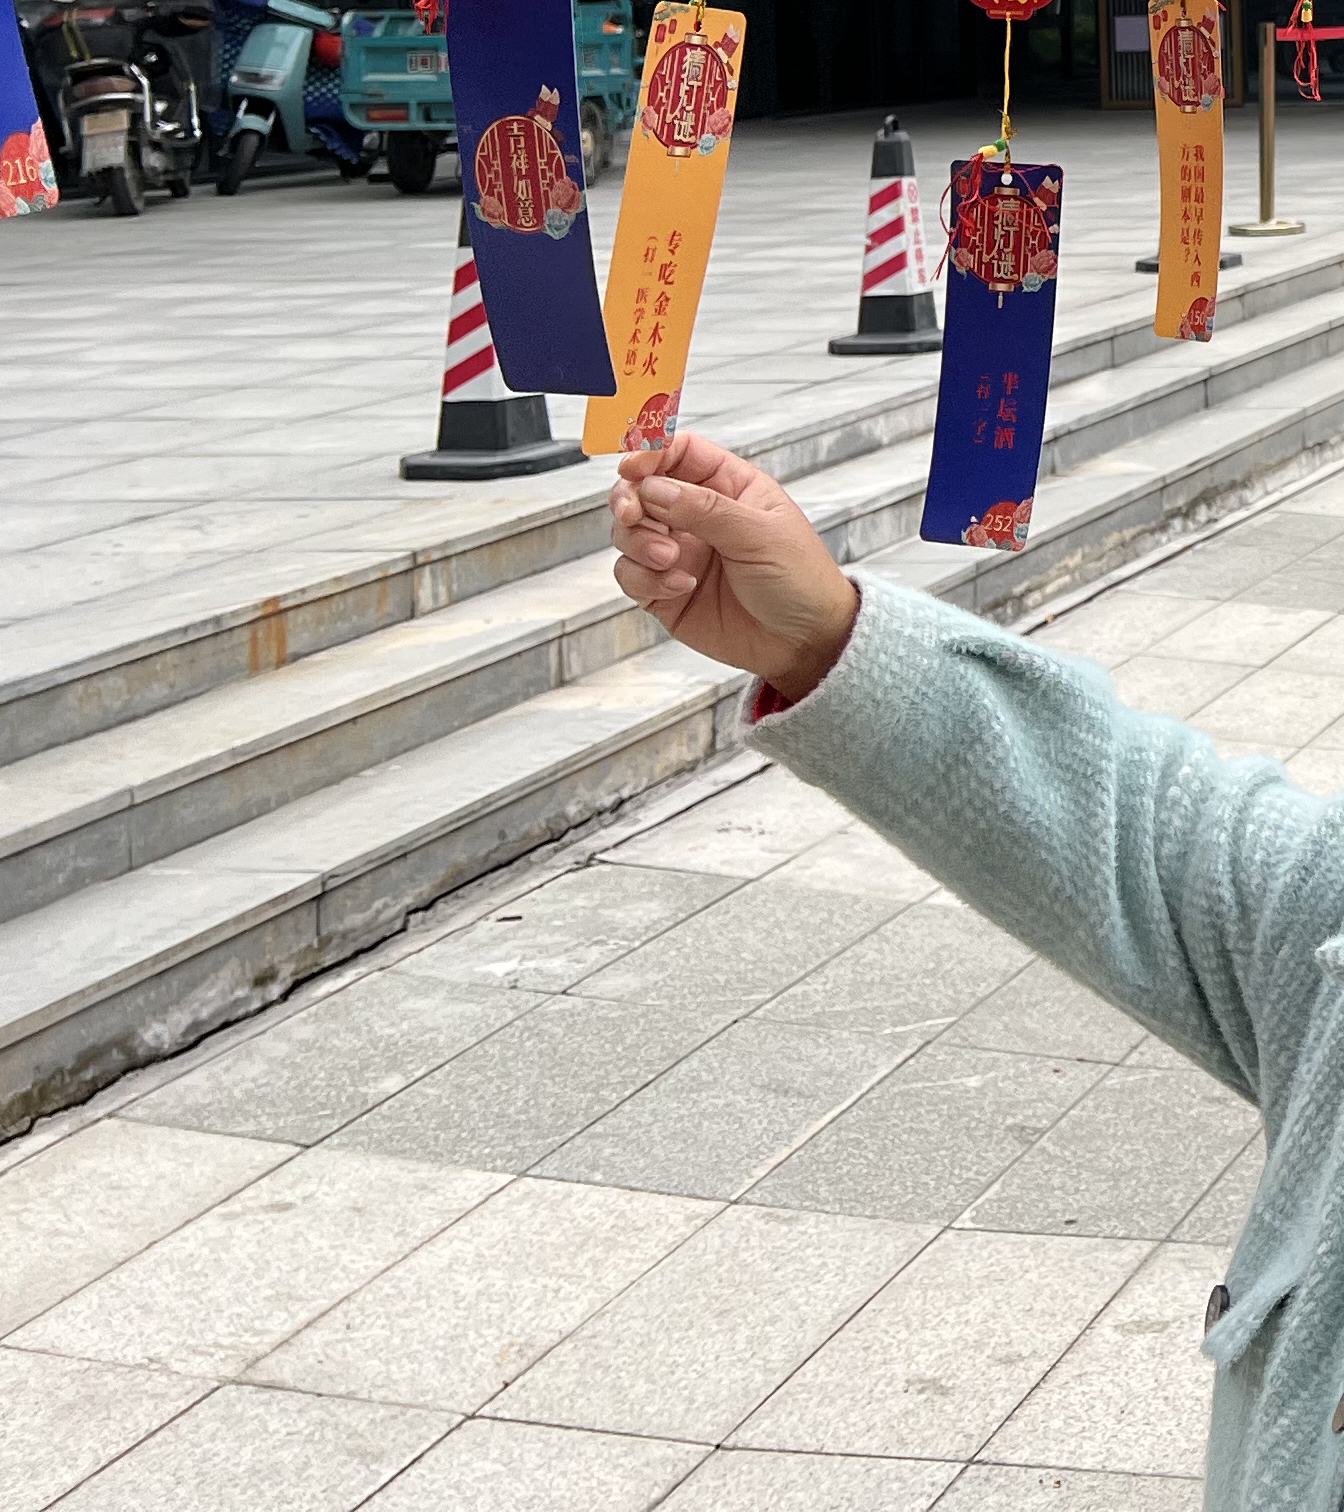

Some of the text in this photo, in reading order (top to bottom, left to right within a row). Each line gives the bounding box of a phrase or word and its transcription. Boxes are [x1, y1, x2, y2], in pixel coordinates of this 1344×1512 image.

[668, 47, 706, 143] 猜灯谜
[3, 156, 38, 186] 216
[506, 122, 537, 226] 吉祥如意
[983, 198, 1020, 279] 猜灯谜
[641, 230, 682, 377] 专吃金木火
[640, 410, 663, 429] 258
[984, 513, 1013, 532] 252
